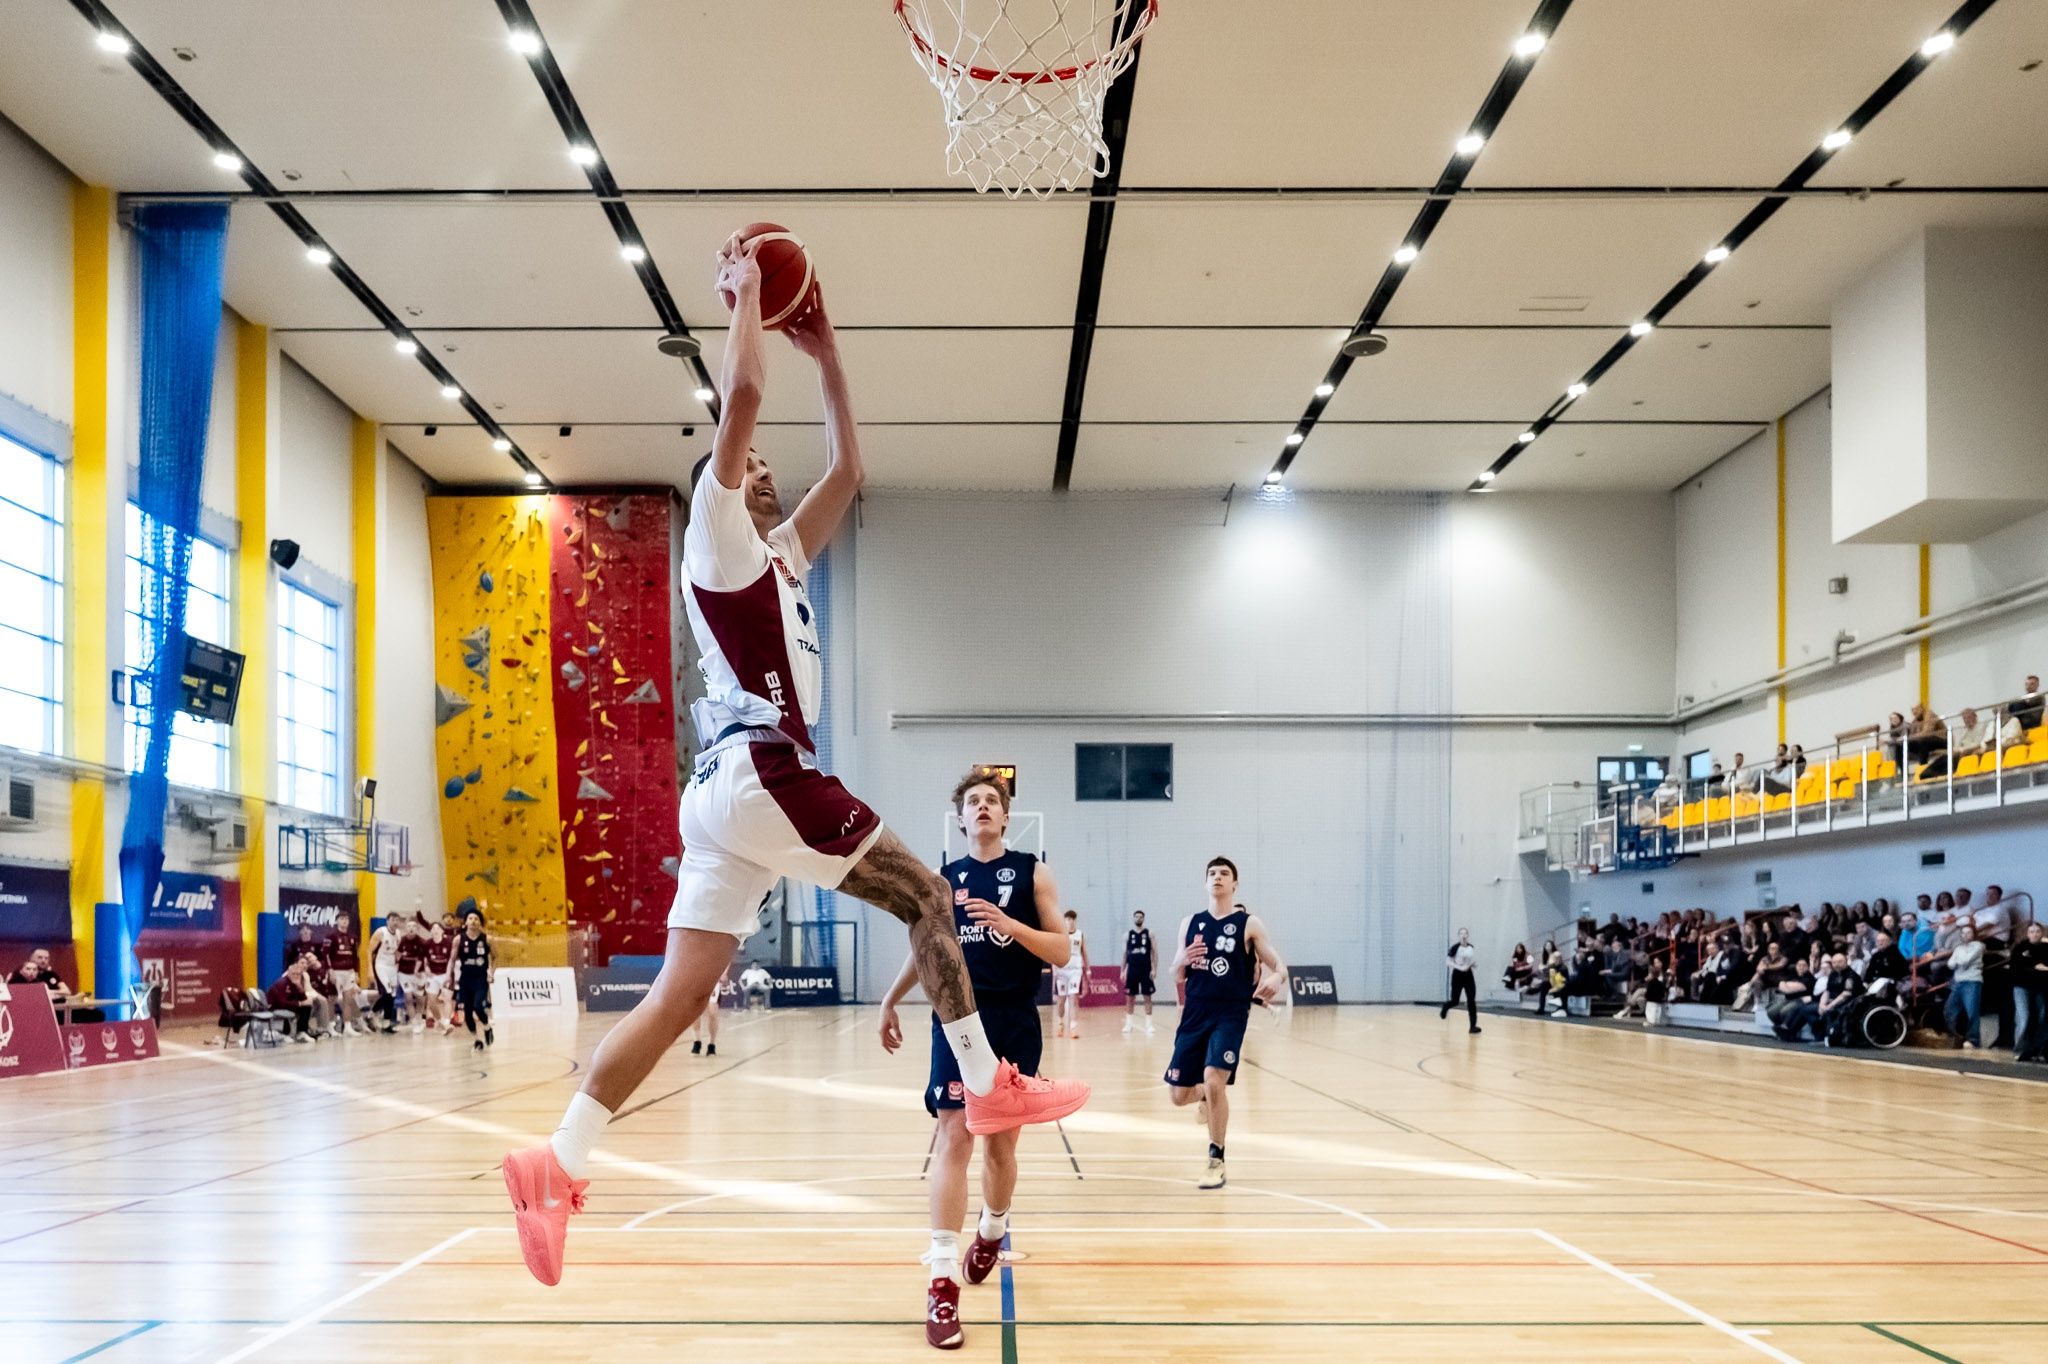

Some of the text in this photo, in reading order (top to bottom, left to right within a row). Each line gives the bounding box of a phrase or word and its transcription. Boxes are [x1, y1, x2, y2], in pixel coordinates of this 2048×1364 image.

[764, 670, 789, 717] RB
[997, 885, 1013, 907] 7
[960, 925, 984, 935] PORT
[1215, 935, 1236, 953] 33
[507, 977, 554, 989] leman
[508, 990, 552, 1000] invest
